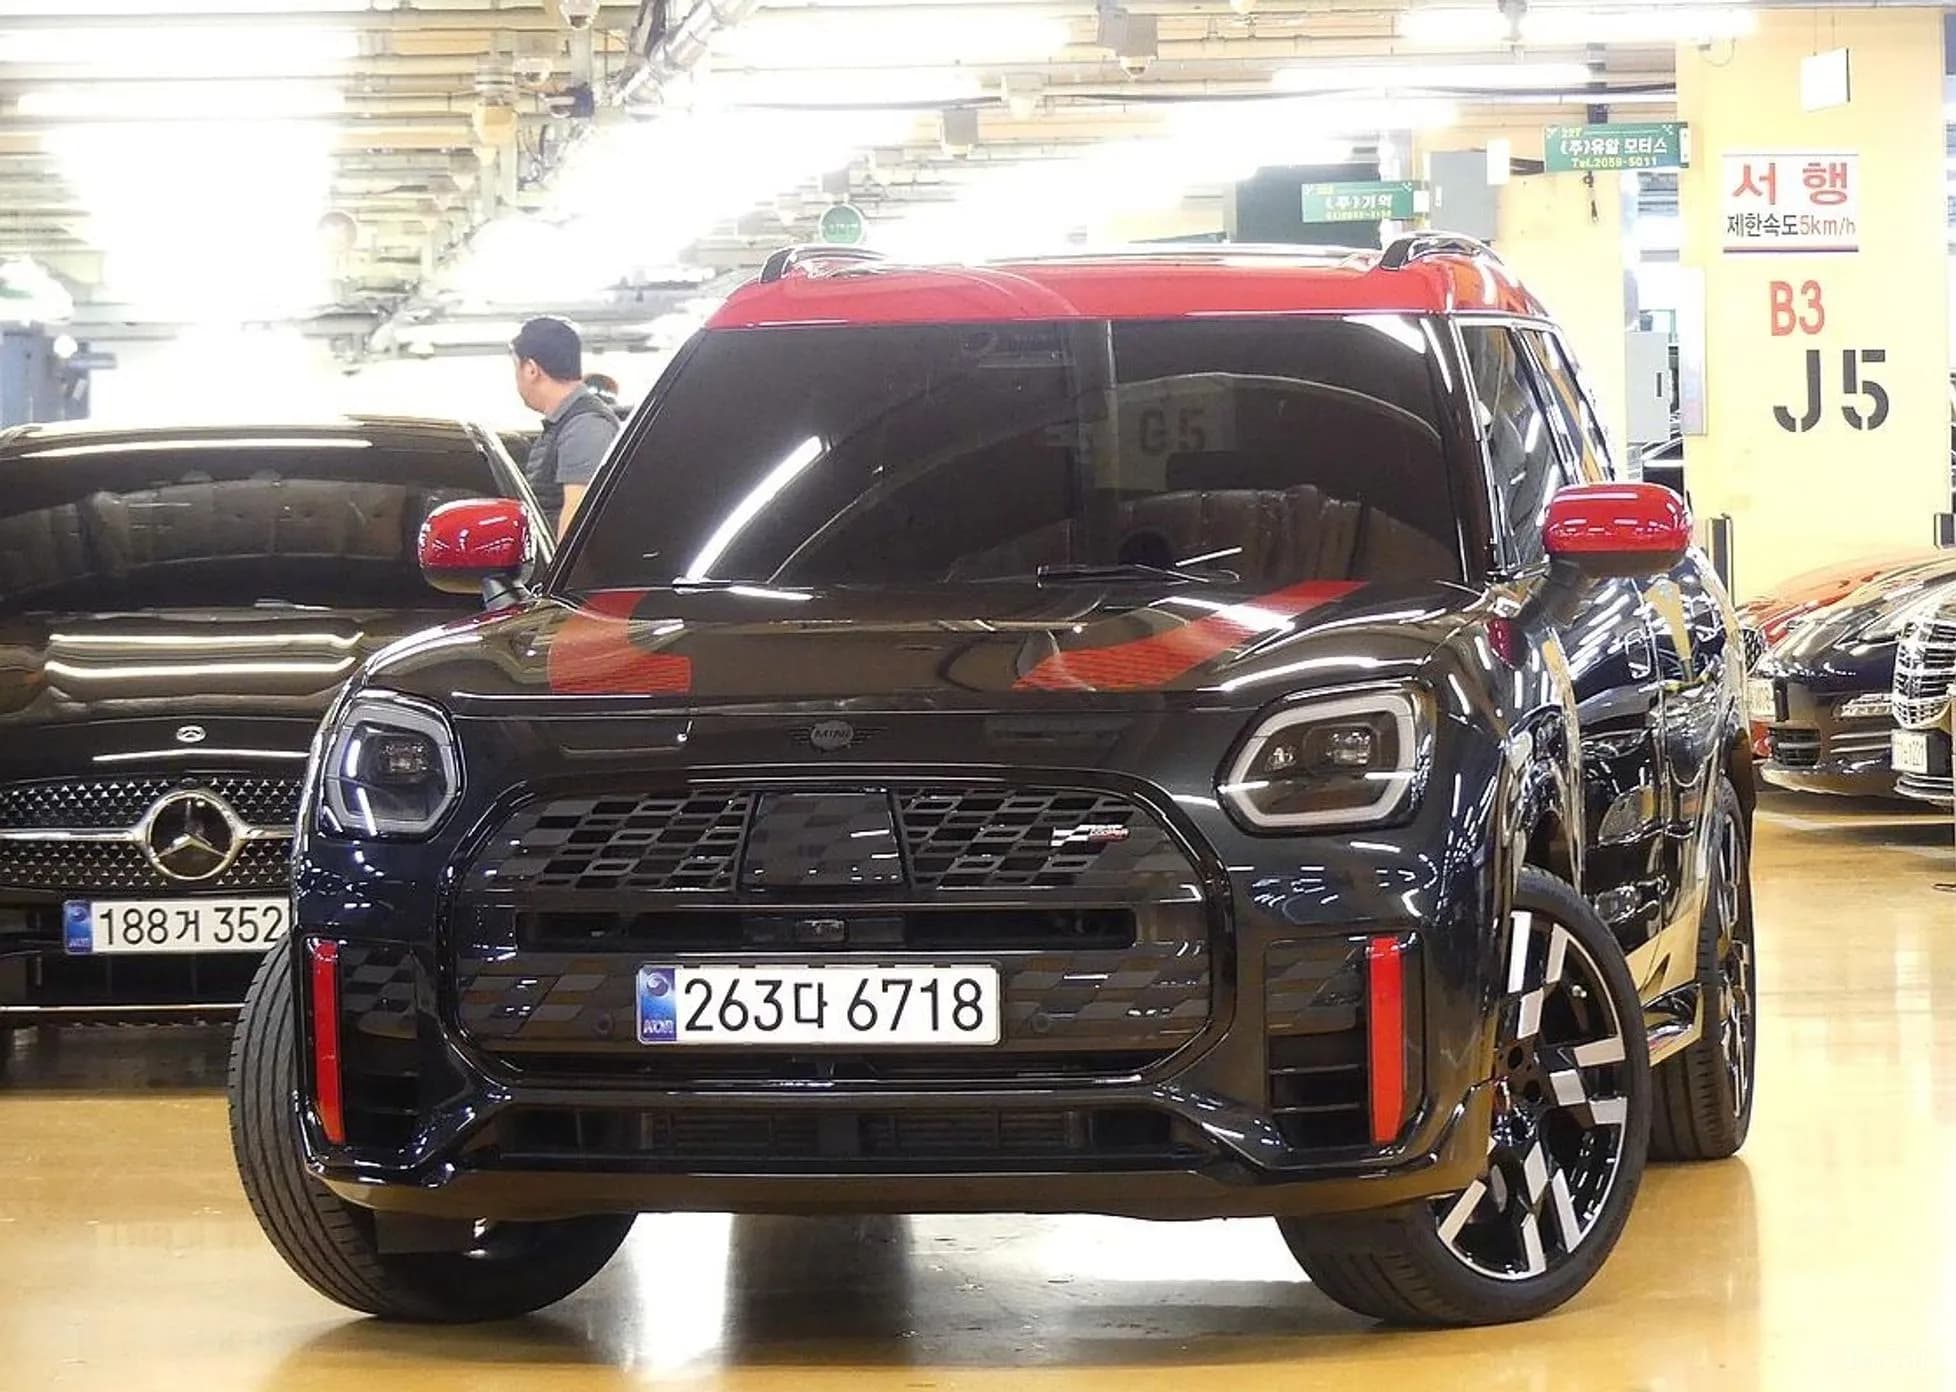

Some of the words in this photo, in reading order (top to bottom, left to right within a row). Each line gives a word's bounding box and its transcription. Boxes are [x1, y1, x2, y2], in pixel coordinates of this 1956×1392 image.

[1624, 137, 1668, 154] 모터스
[1769, 281, 1825, 336] B3
[1773, 349, 1889, 432] J5
[99, 908, 199, 945] 188거
[684, 978, 828, 1031] 263다
[847, 978, 983, 1031] 6718
